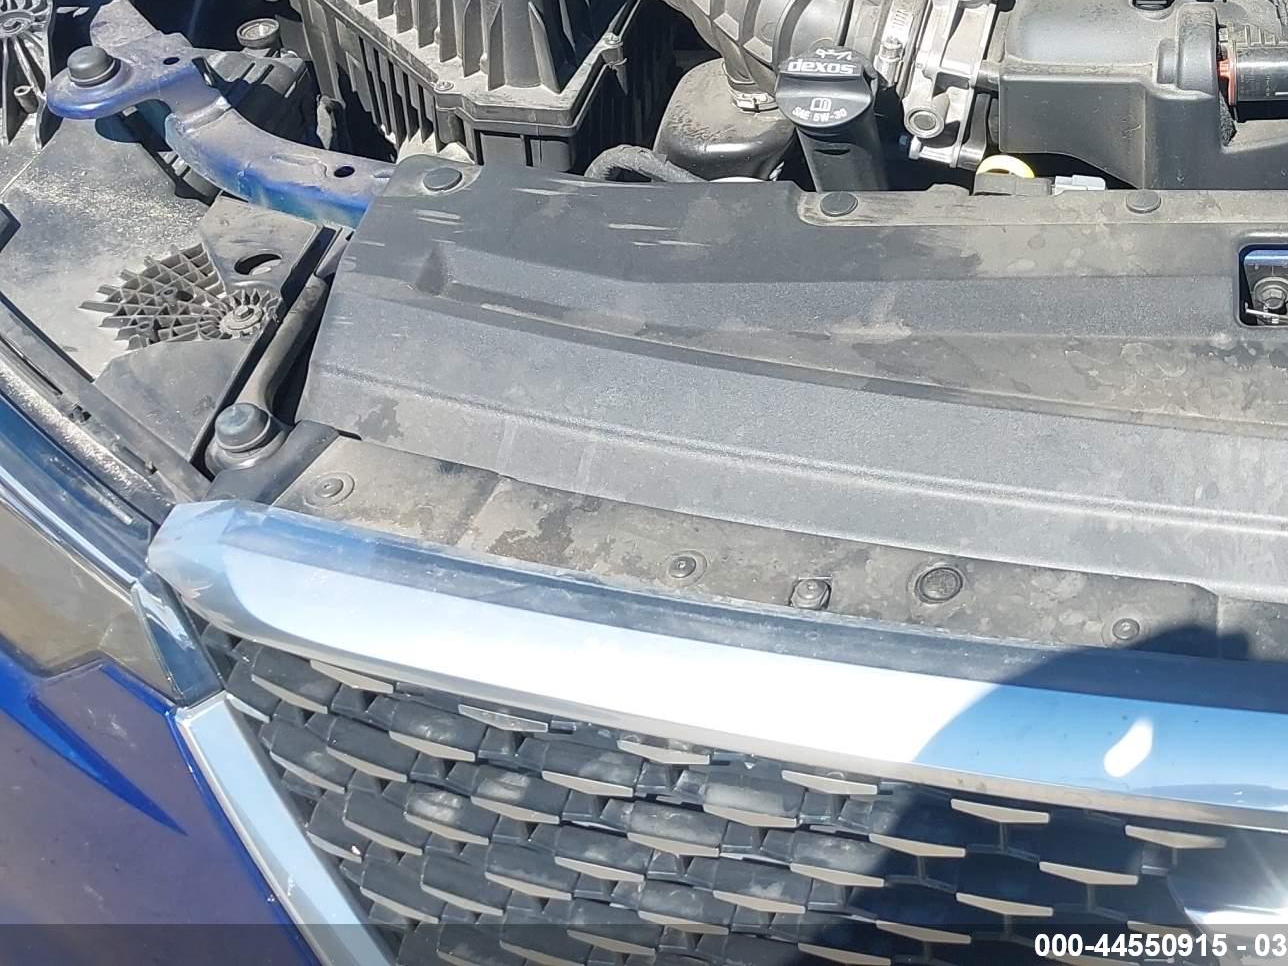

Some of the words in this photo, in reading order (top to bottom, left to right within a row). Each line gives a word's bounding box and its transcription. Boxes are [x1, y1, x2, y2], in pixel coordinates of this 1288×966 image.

[788, 59, 857, 74] dexos
[792, 106, 811, 120] SAE
[812, 107, 847, 123] 5W-30
